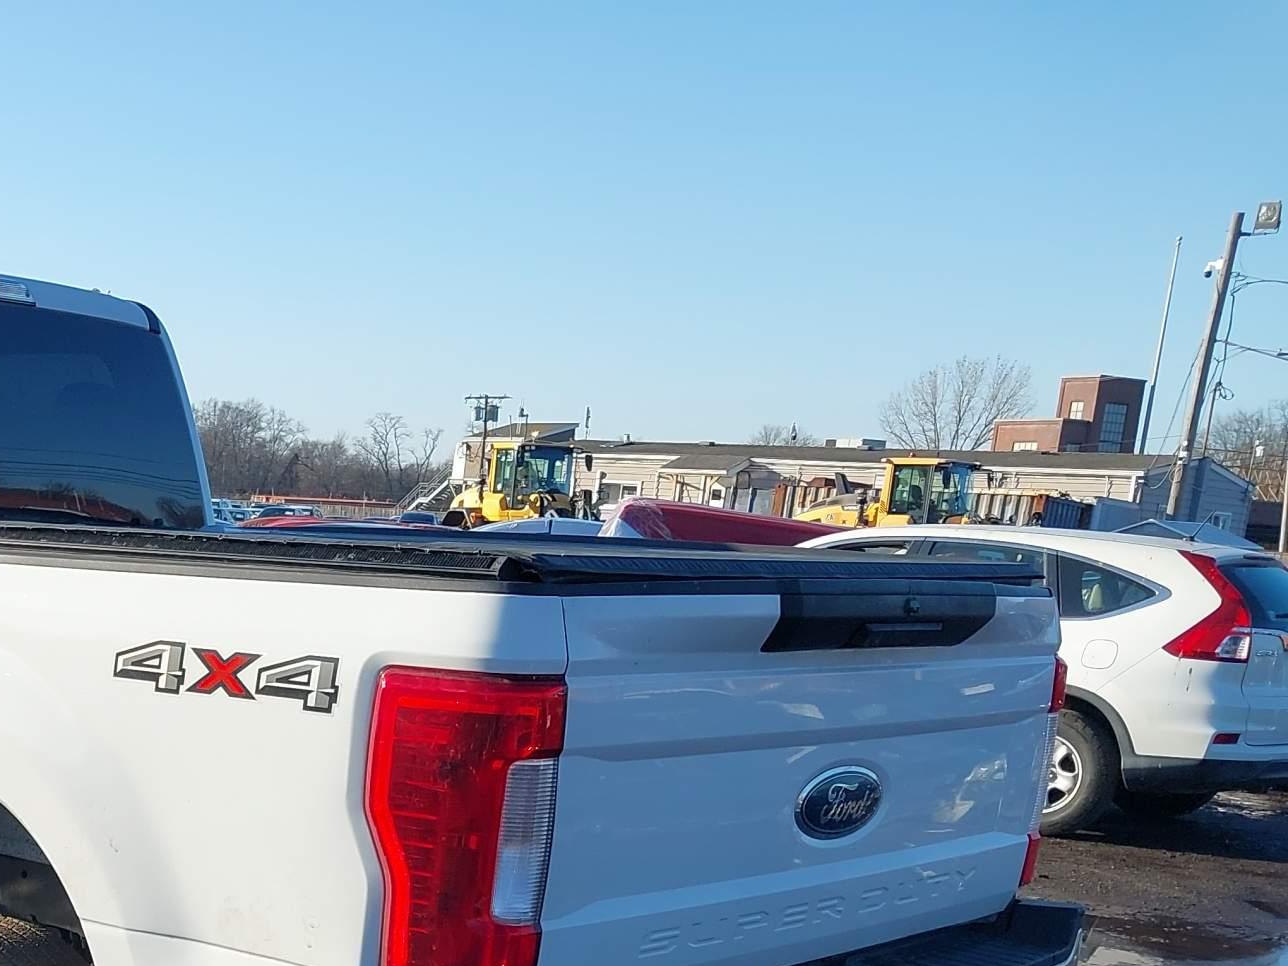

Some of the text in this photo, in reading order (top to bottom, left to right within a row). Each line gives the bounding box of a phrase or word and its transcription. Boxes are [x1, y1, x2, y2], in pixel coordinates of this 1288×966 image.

[113, 640, 340, 714] 4X4
[819, 782, 883, 825] Ford
[637, 866, 977, 959] SUPER DUTY
